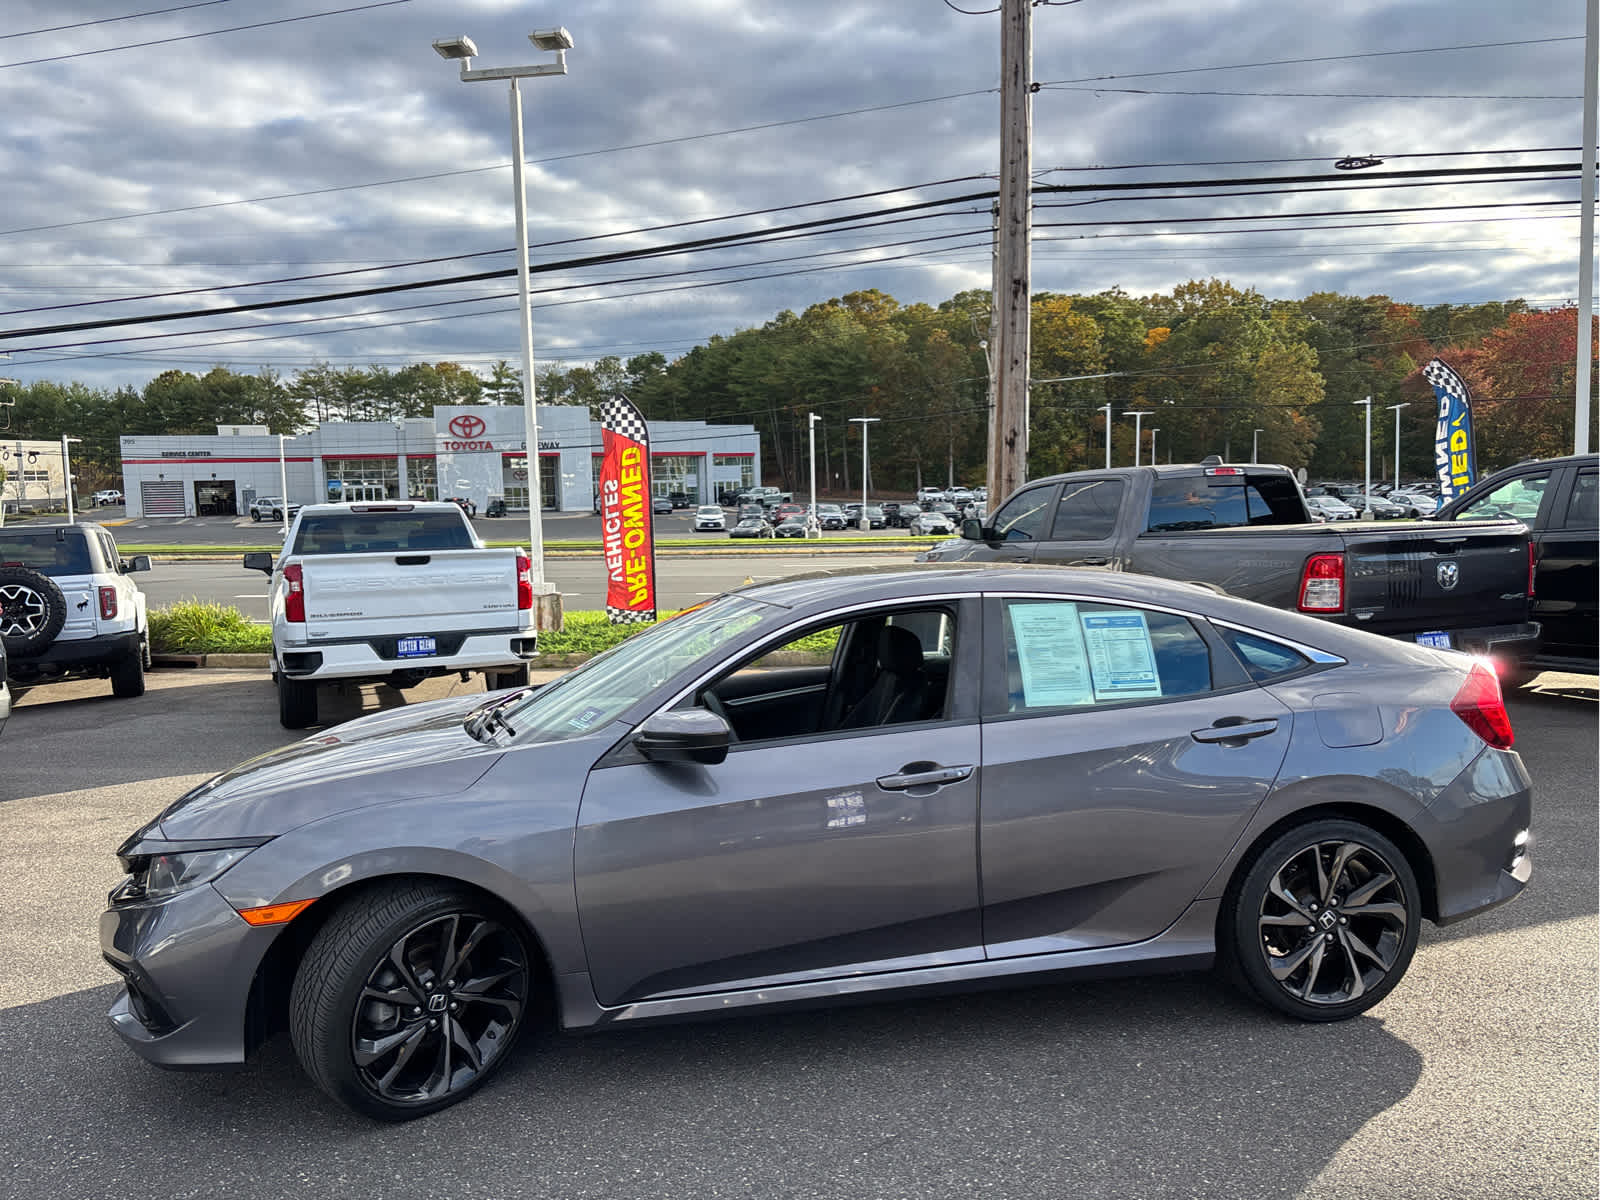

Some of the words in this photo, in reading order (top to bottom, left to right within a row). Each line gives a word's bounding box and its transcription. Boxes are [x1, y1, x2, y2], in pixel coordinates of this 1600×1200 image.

[443, 441, 494, 451] TOYOTA
[520, 442, 560, 450] GEWAY
[398, 640, 417, 652] LESTER
[419, 639, 436, 650] GLENN
